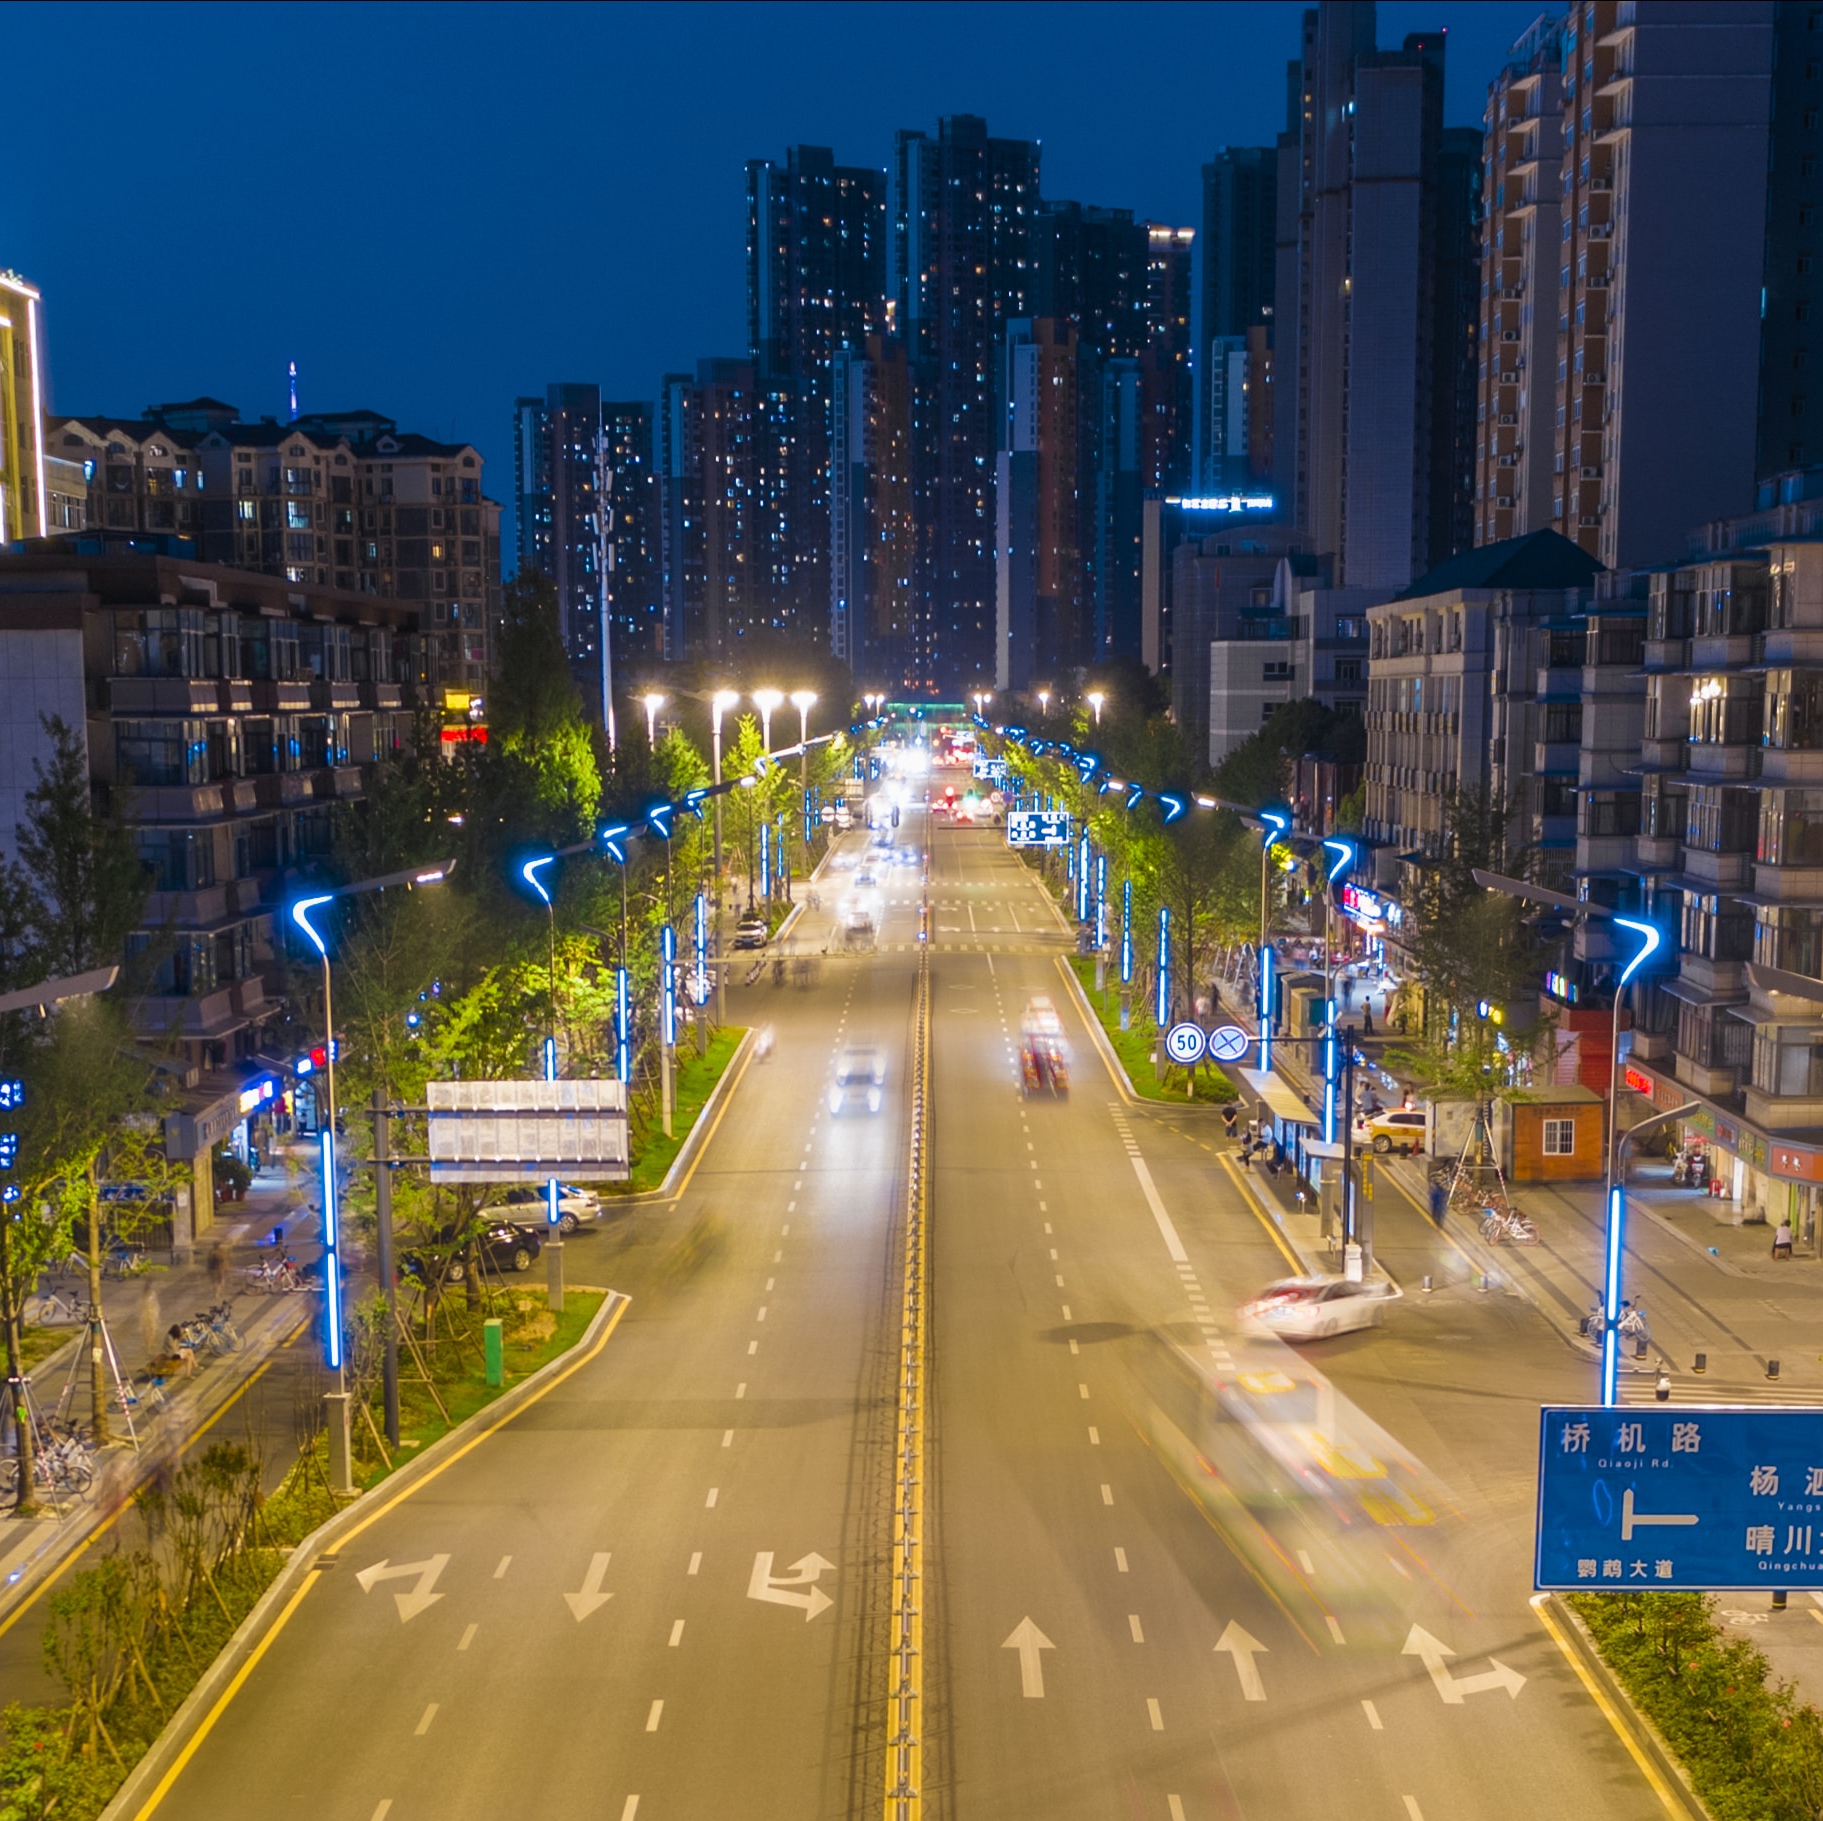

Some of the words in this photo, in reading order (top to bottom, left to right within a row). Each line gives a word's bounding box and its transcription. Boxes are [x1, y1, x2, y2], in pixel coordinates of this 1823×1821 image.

[1177, 1034, 1197, 1051] 50
[1561, 1422, 1701, 1453] 桥机路
[1598, 1458, 1643, 1470] Qiaoji
[1577, 1559, 1673, 1578] 鹦鹉大道
